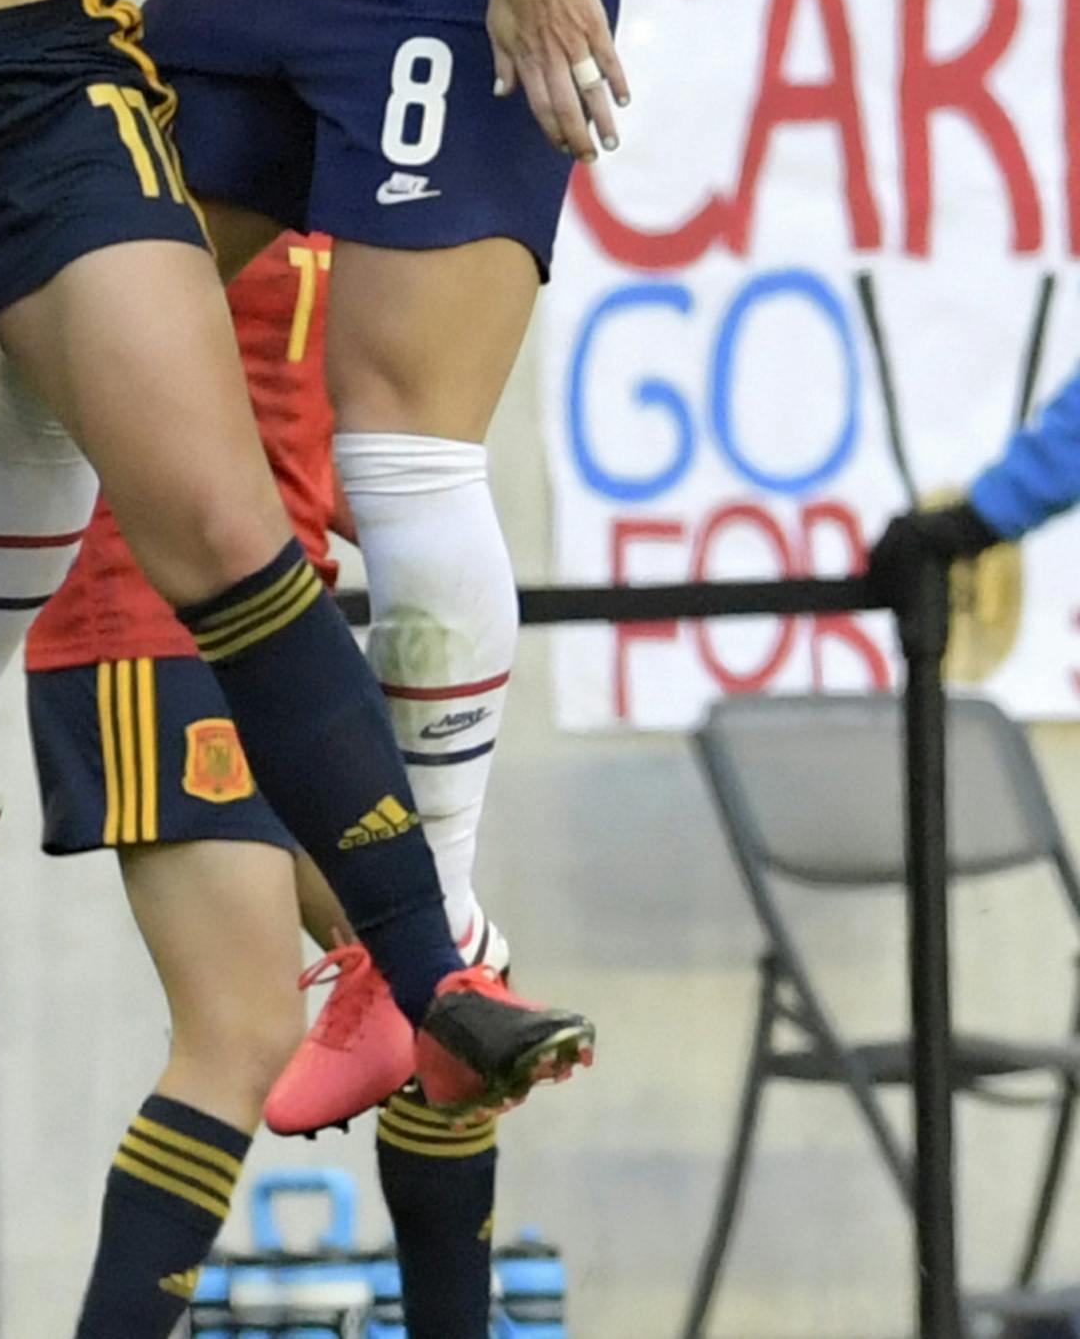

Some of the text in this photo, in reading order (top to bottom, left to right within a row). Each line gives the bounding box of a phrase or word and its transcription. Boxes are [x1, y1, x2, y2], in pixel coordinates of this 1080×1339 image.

[86, 83, 184, 203] 11
[381, 36, 453, 166] 8
[567, 268, 862, 501] GO
